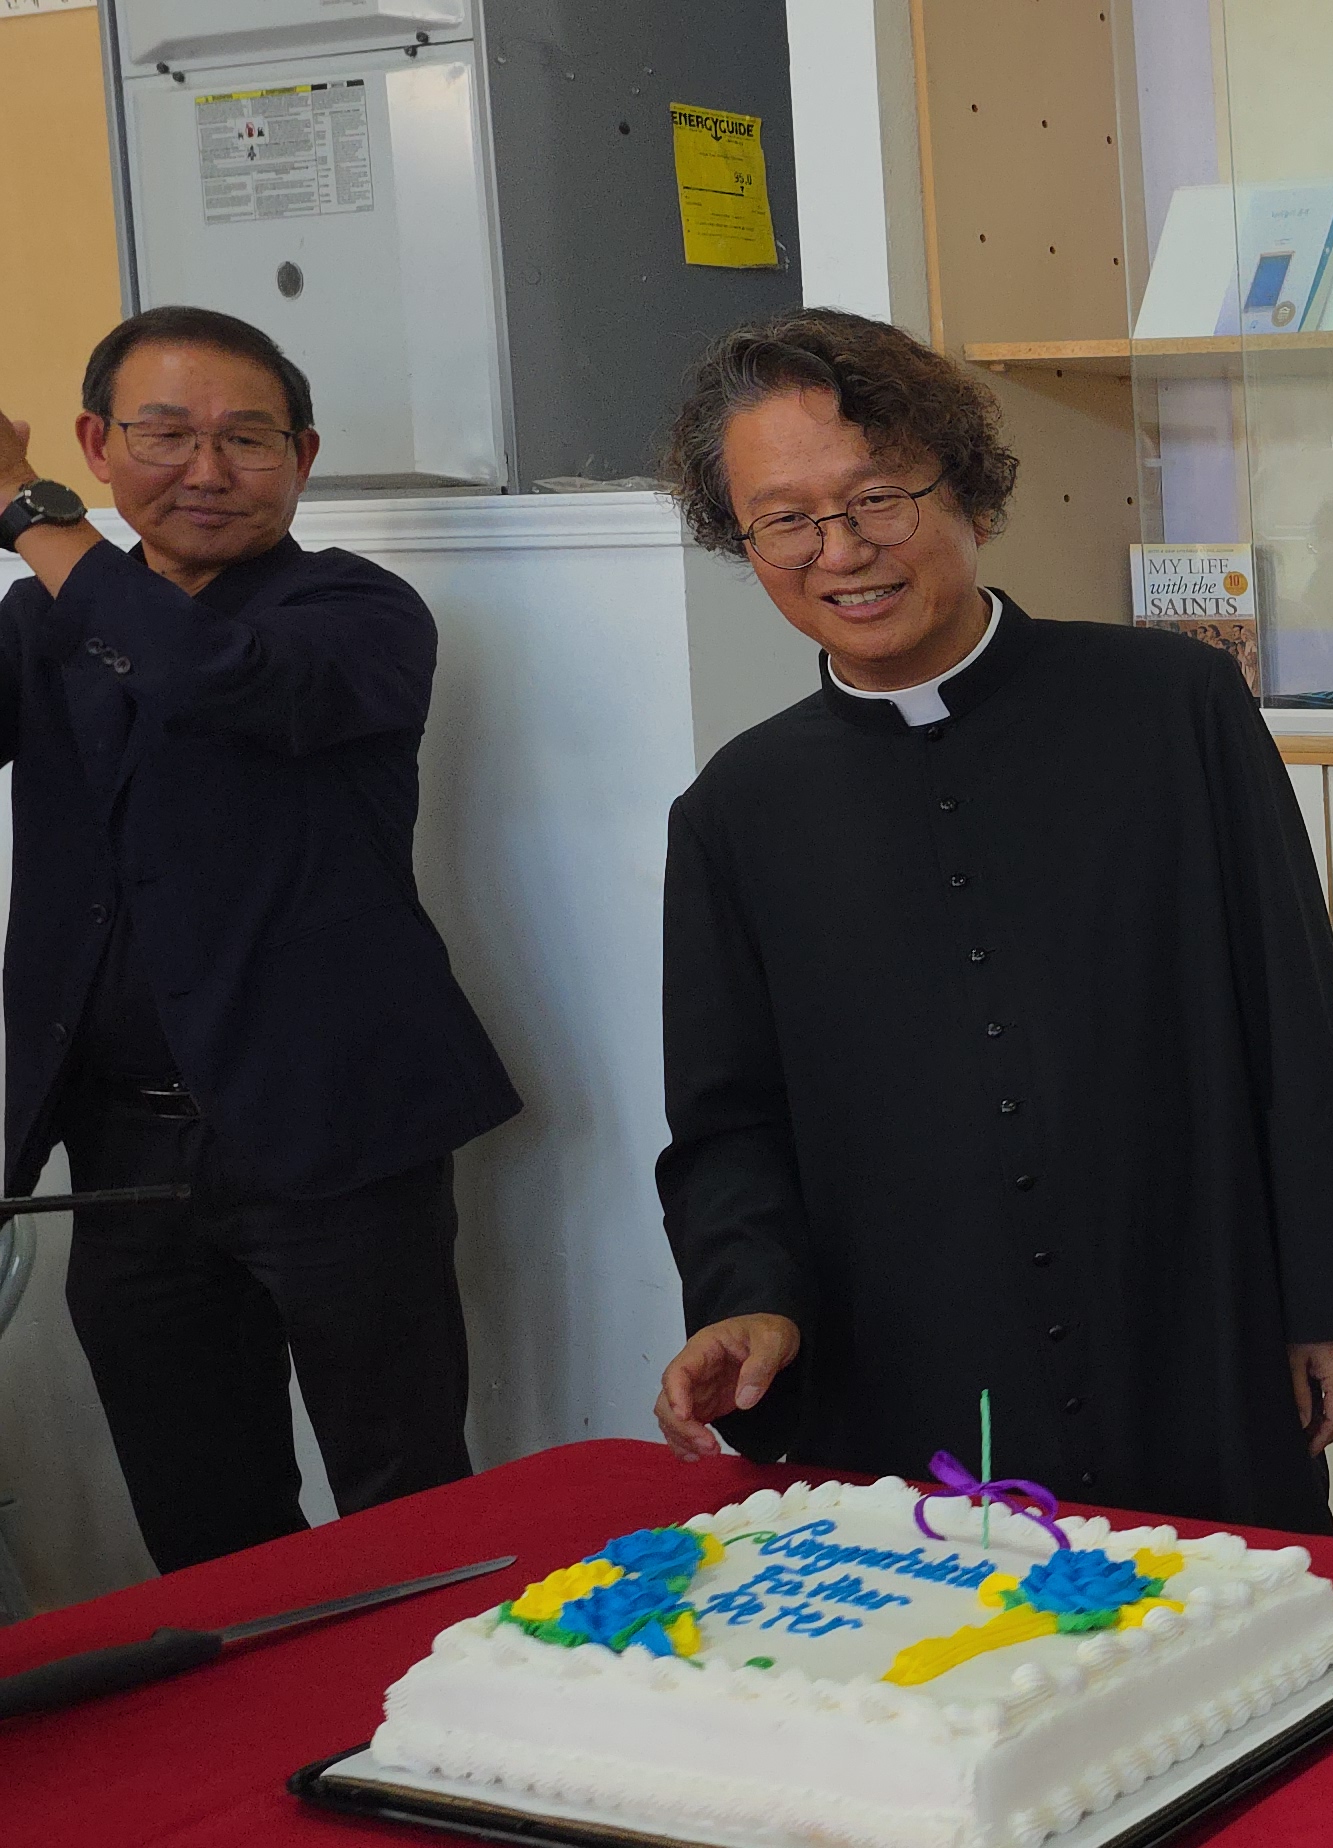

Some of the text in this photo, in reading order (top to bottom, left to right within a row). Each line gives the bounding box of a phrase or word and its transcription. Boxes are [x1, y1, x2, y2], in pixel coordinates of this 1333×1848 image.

[1148, 558, 1230, 574] MY LIFE
[1150, 576, 1217, 595] with the
[1228, 575, 1240, 587] 10
[1150, 597, 1238, 616] SAINTS
[696, 1591, 864, 1638] Peter
